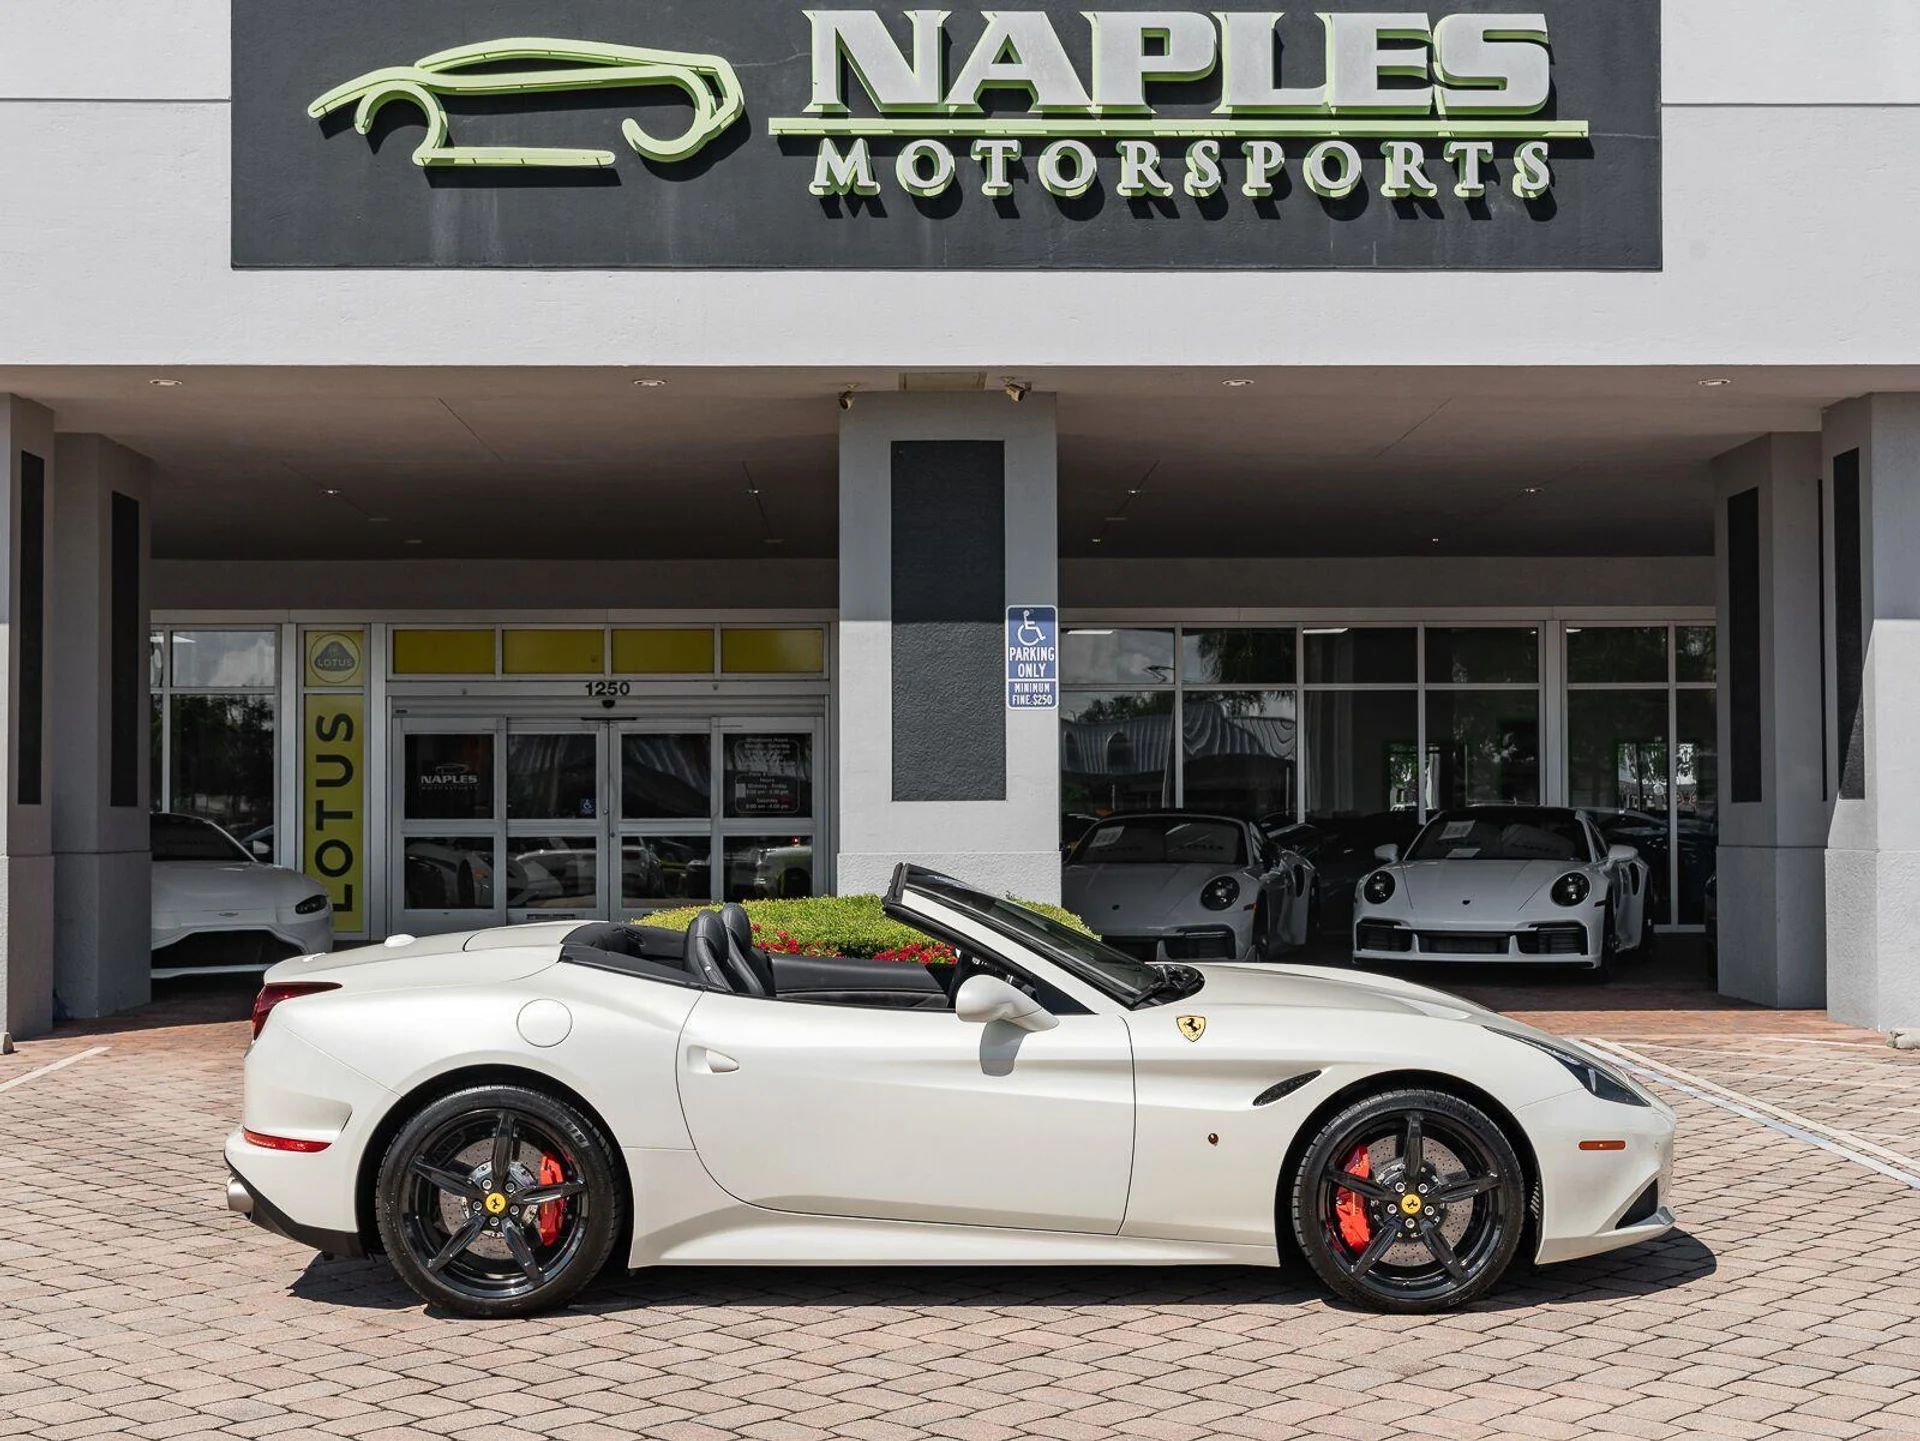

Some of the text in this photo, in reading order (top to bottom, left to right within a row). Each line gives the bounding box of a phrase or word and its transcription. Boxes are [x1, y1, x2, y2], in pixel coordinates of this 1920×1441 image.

[802, 9, 1551, 115] NAPLES
[808, 138, 1553, 198] MOTORSPORTS
[1009, 646, 1055, 661] PARKING
[317, 658, 353, 667] LOTUS
[1018, 663, 1046, 678] ONLY
[585, 681, 630, 696] 1250
[1015, 683, 1050, 693] MINIMUM
[1012, 694, 1053, 706] FINE $250
[421, 775, 478, 784] NAPLES
[315, 713, 354, 912] LOTUS
